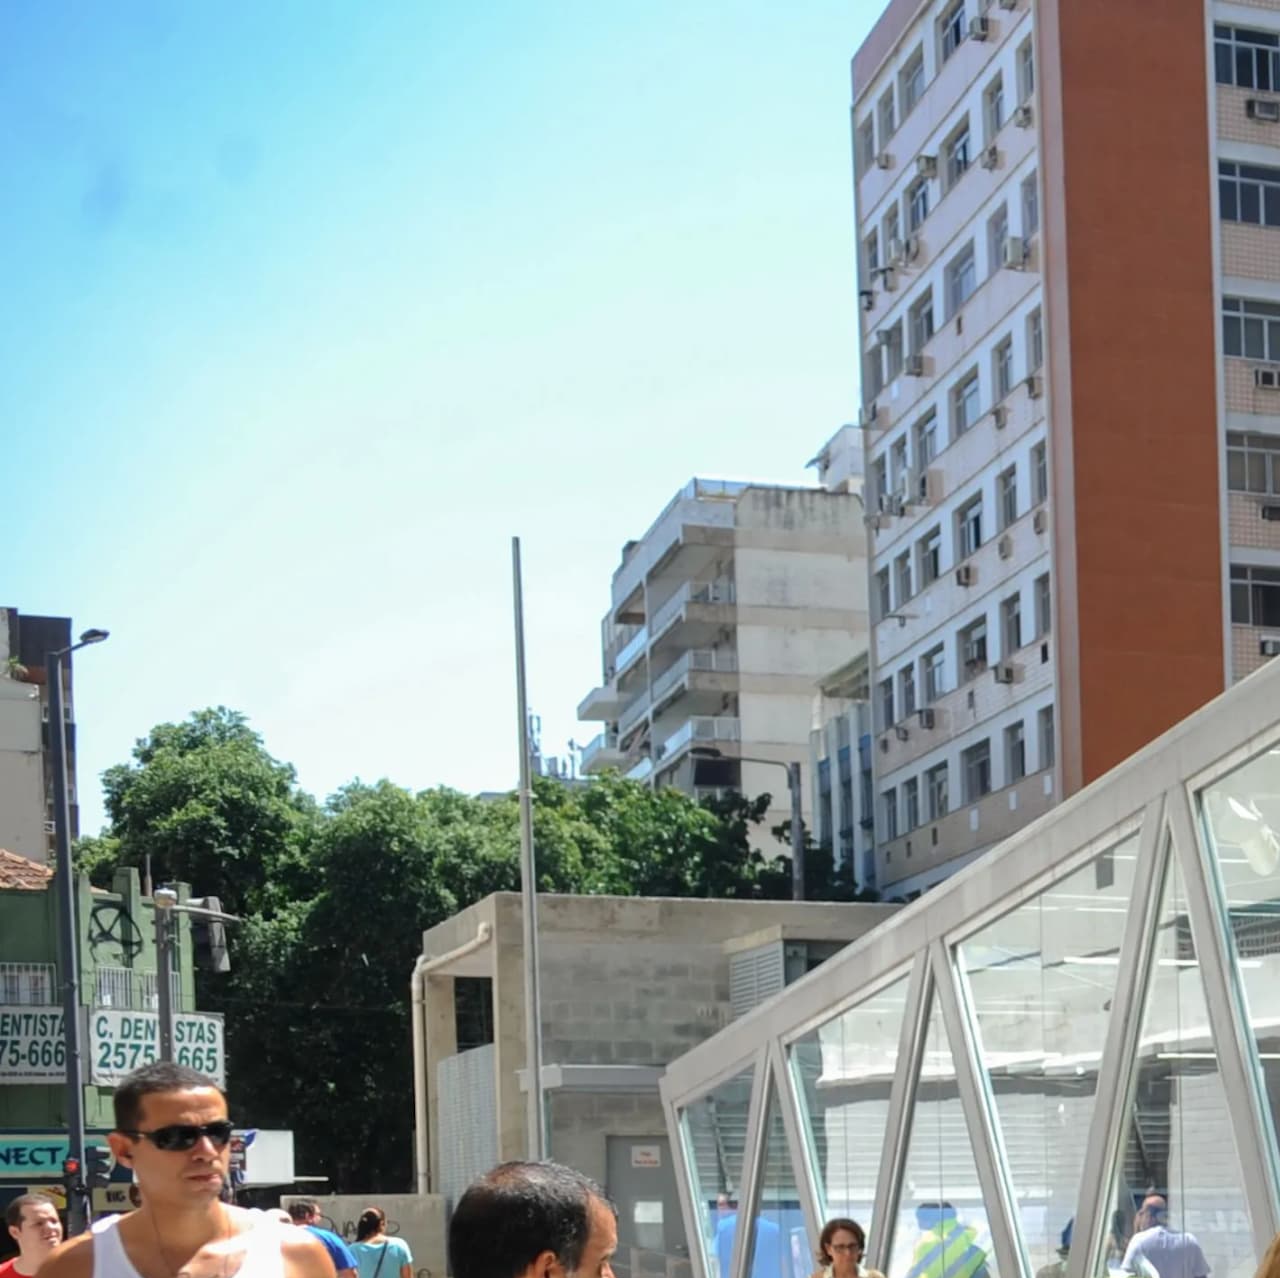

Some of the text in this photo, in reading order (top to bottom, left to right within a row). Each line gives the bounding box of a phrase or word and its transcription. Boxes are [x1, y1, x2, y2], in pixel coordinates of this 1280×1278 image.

[96, 1016, 216, 1044] C. DENSTAS
[98, 1042, 217, 1073] 2575665
[0, 1146, 68, 1167] NECT
